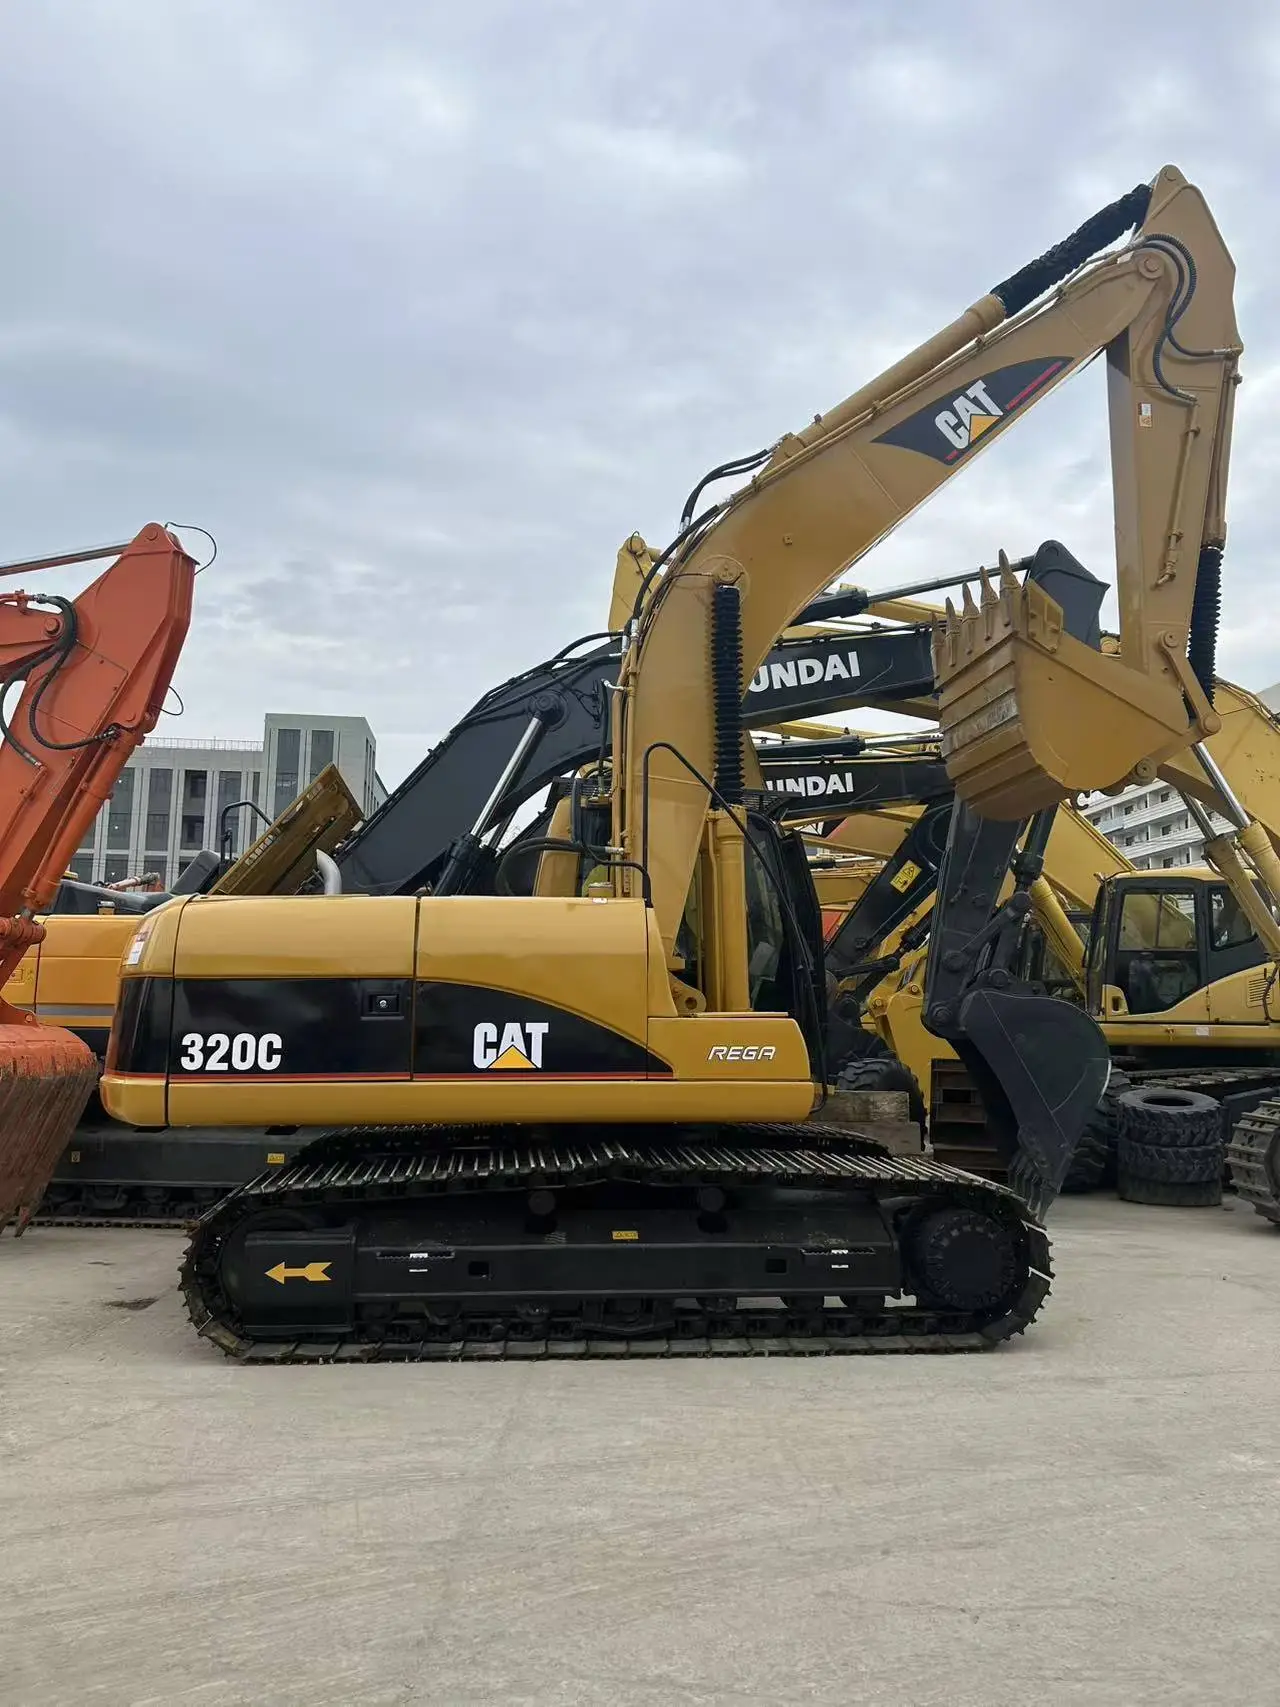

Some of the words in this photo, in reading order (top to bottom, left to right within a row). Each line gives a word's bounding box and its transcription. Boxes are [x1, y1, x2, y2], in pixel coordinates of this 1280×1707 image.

[935, 380, 1003, 449] CAT
[180, 1032, 282, 1071] 320C
[473, 1022, 549, 1069] CAT
[707, 1045, 777, 1061] REGA
